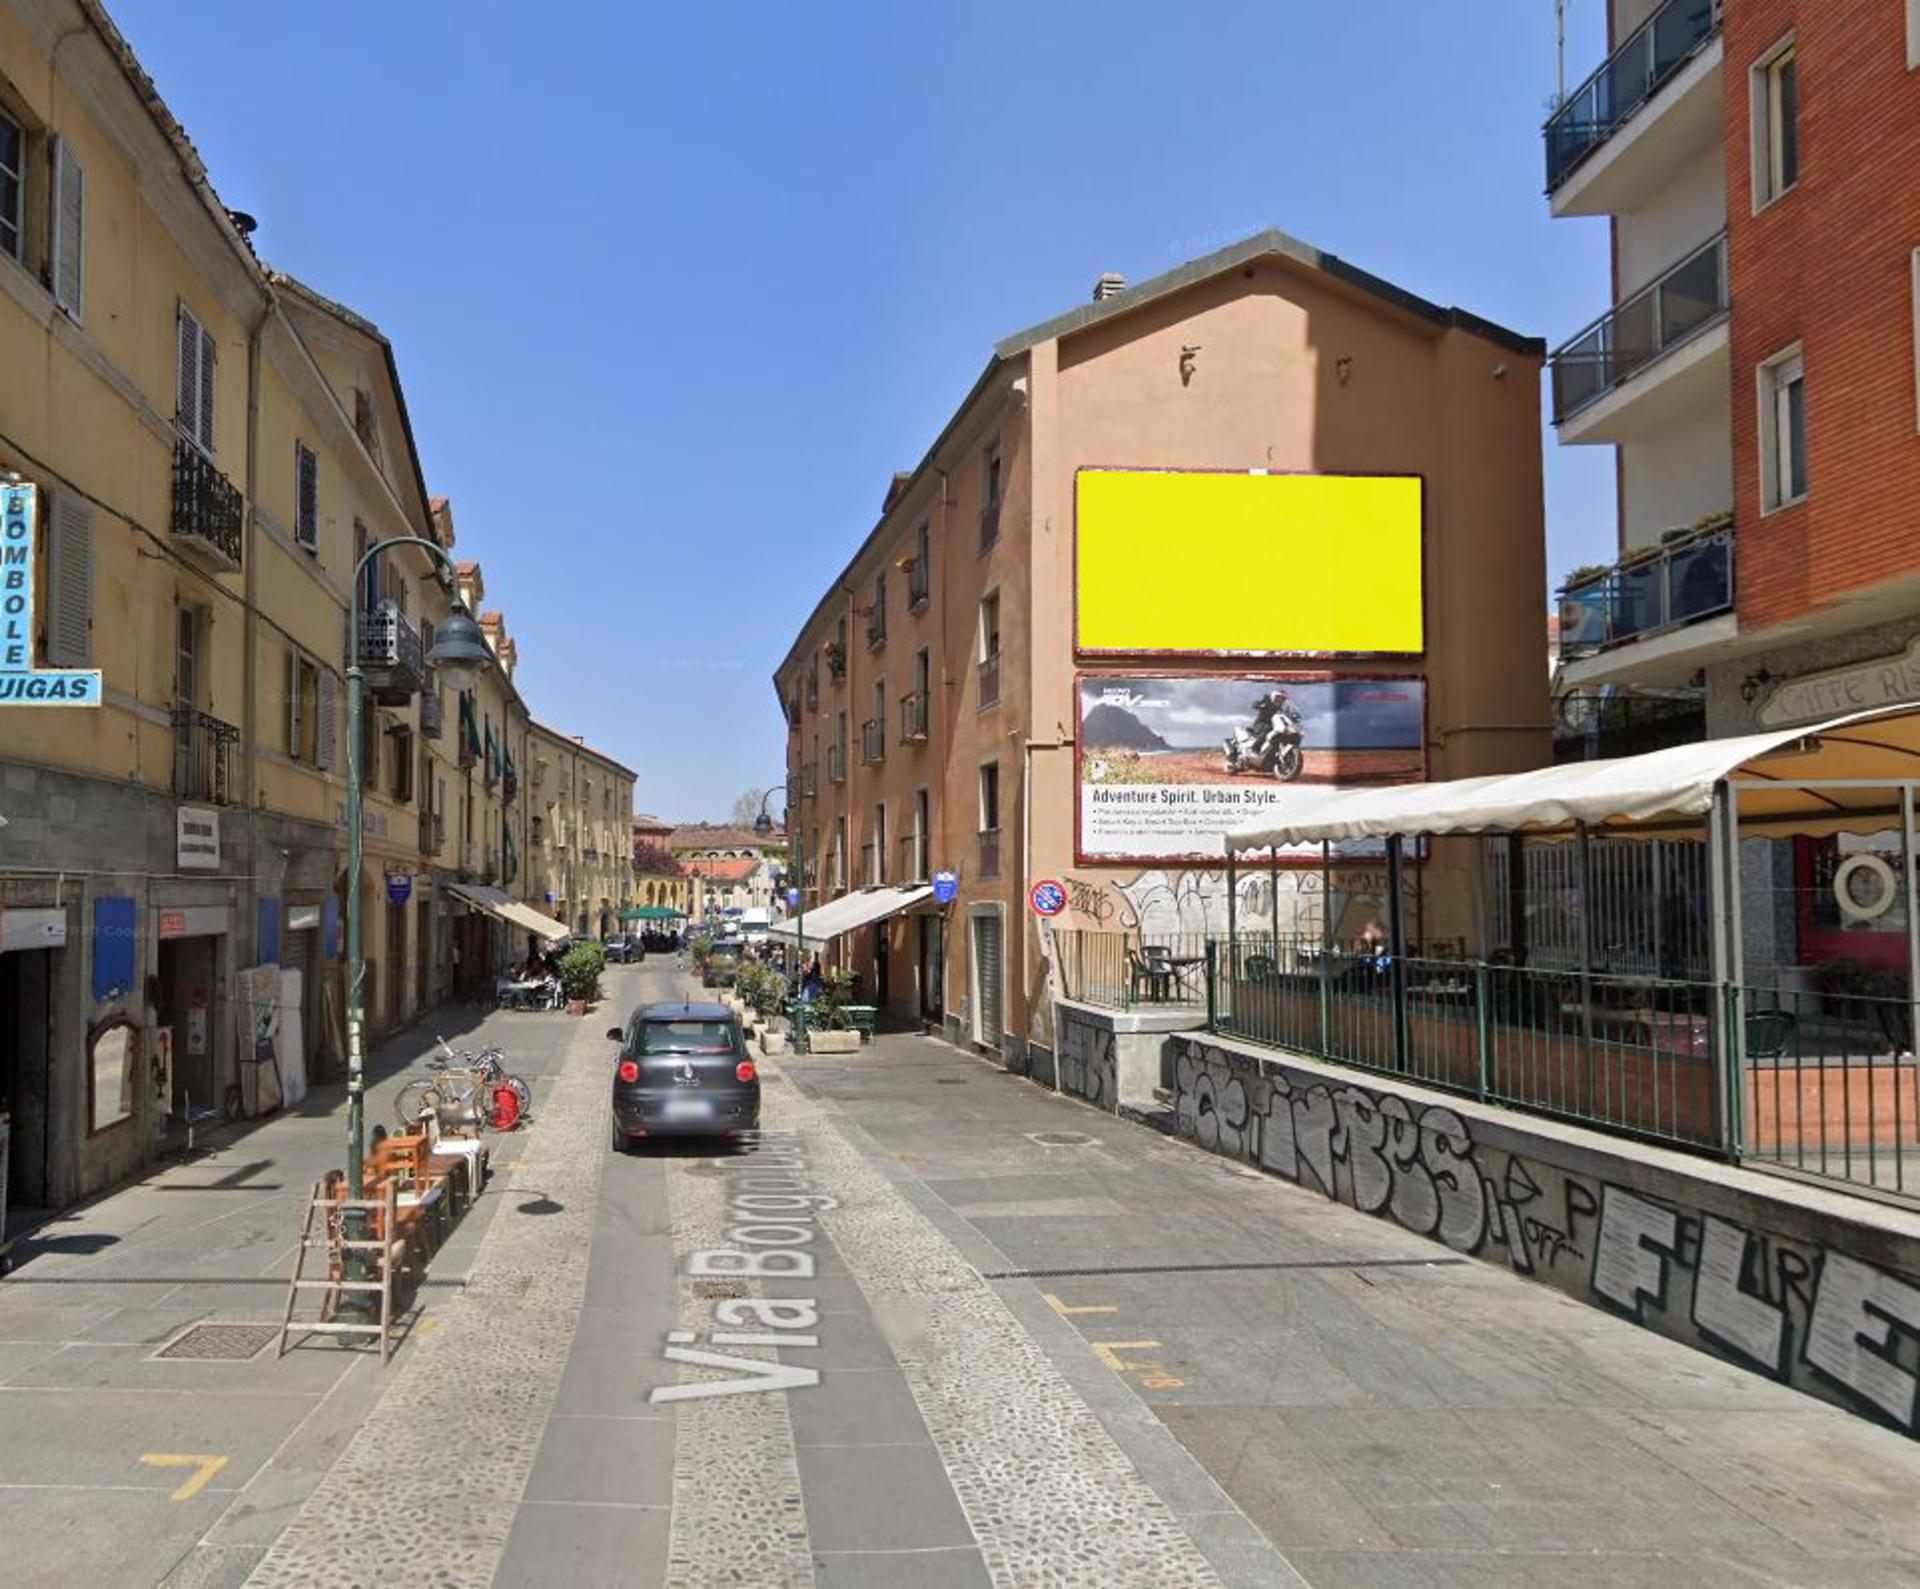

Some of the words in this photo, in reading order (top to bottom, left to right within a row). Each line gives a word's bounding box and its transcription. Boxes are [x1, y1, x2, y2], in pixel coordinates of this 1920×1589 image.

[4, 496, 28, 665] BOMBOLE
[0, 677, 89, 699] UIGAS
[1093, 788, 1157, 803] Adventure
[1203, 789, 1240, 803] Urban
